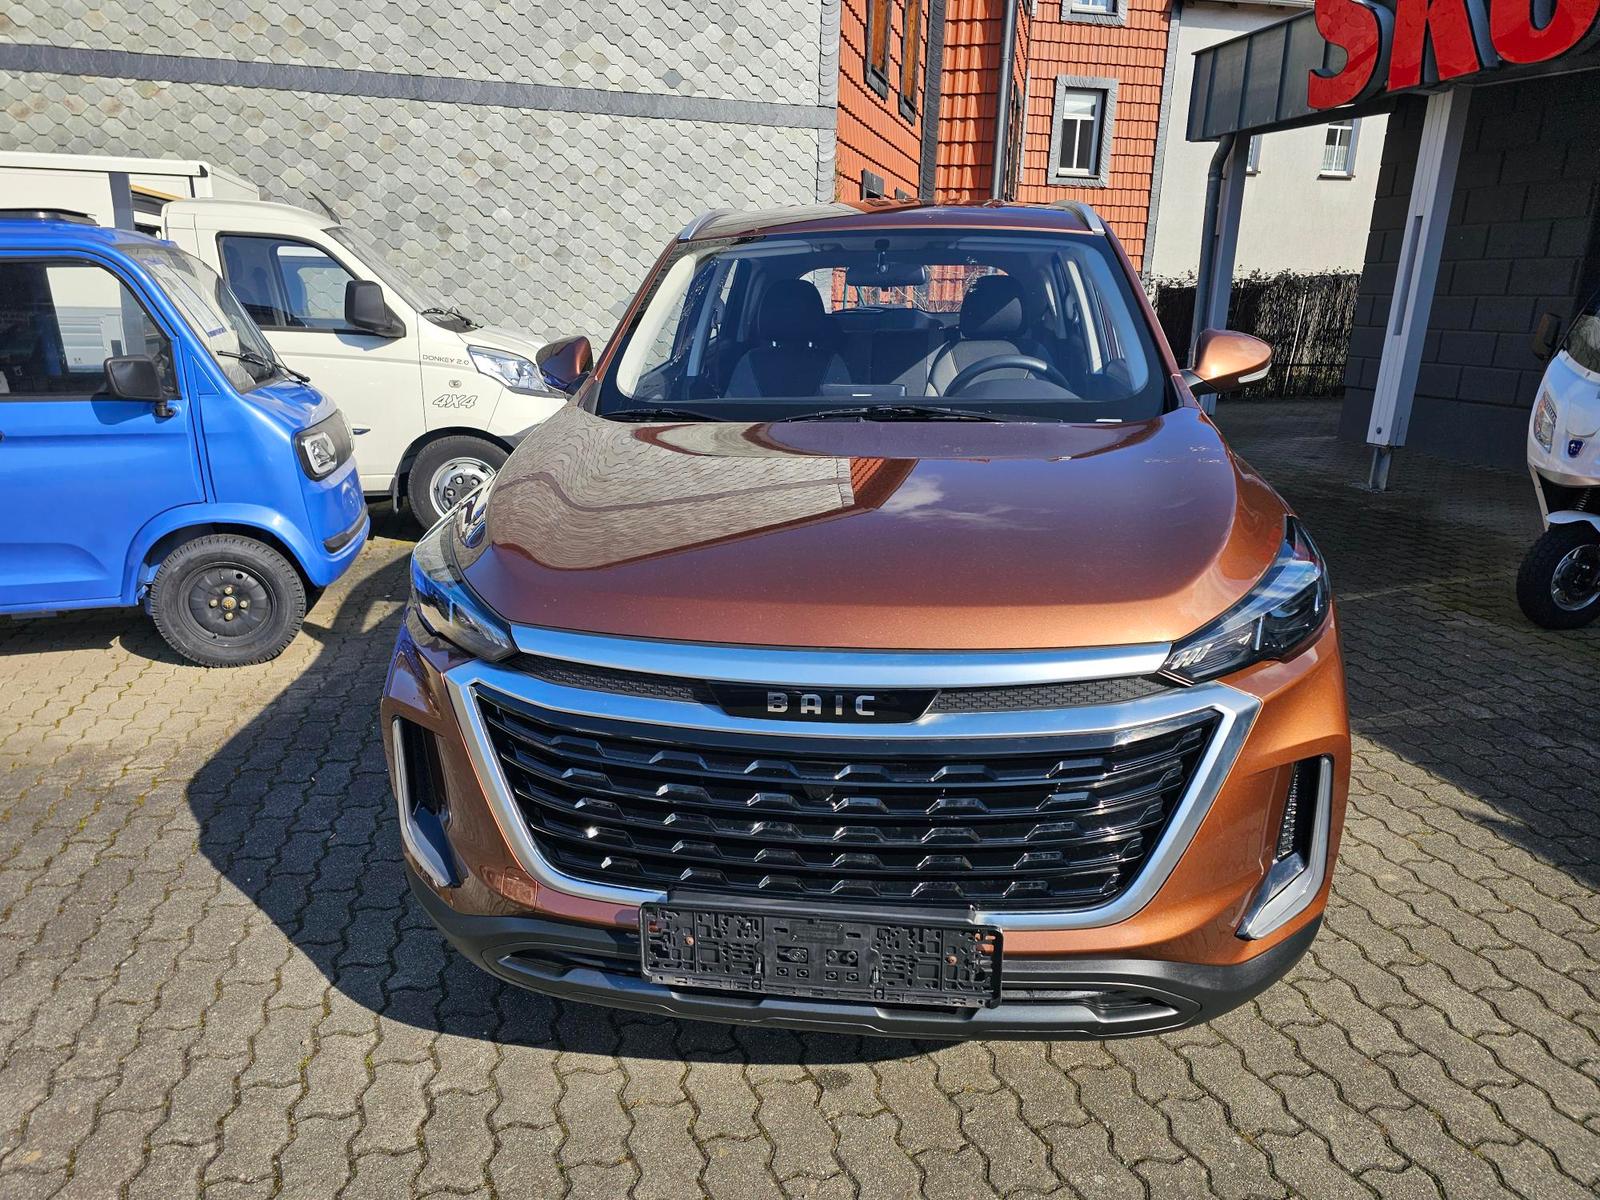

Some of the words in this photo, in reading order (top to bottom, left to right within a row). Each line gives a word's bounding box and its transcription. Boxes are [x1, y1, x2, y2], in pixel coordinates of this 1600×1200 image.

[422, 354, 455, 363] DONKEY
[456, 358, 470, 366] 2.0
[432, 394, 478, 409] 4X4
[767, 691, 875, 716] BAIC
